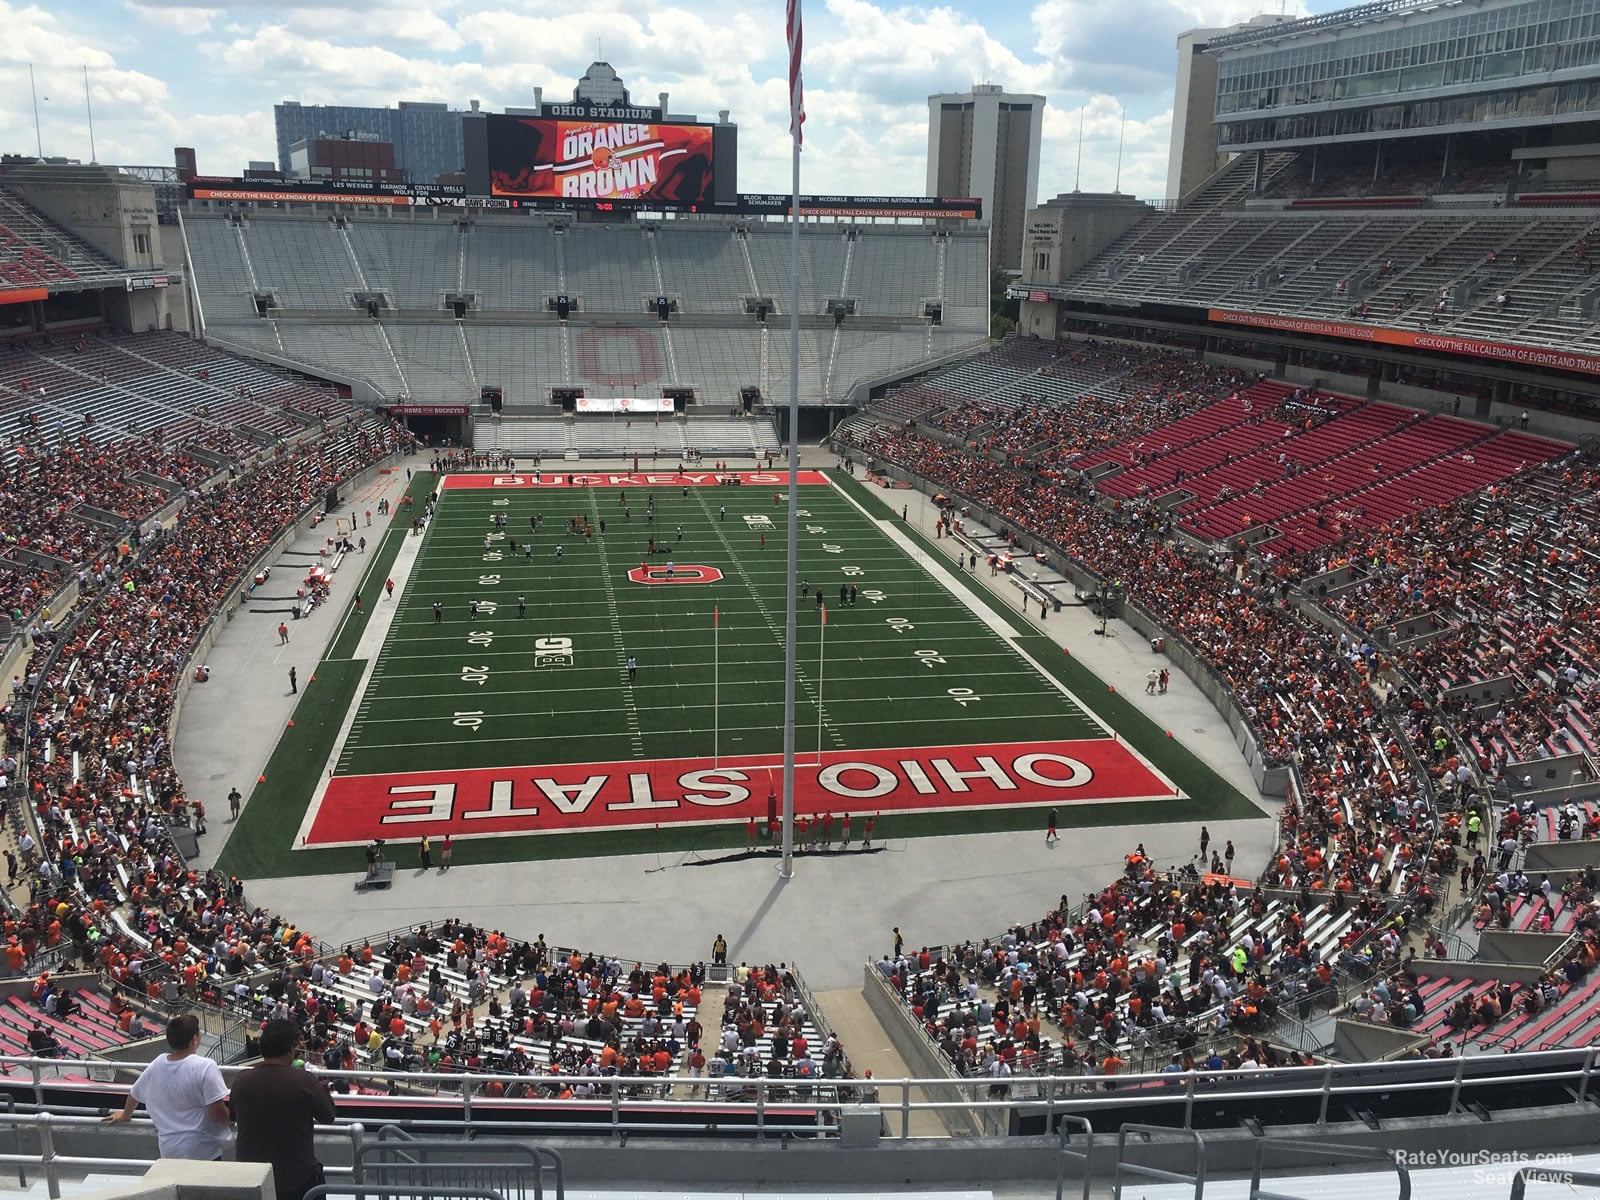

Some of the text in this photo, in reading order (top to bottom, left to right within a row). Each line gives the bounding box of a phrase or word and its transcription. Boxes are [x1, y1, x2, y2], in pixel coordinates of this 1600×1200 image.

[552, 106, 653, 120] OHIO STADIUM
[564, 122, 650, 161] ORANGE
[562, 154, 657, 198] BROWN
[486, 200, 506, 208] POUND
[1270, 319, 1296, 329] CALENDAR
[1304, 323, 1324, 331] EVENTS
[1337, 327, 1356, 336] TRAVEL
[1357, 329, 1374, 338] GUIDE
[1414, 336, 1600, 371] CHECK OUT THE FALL CALENDAR OF EVENTS AND TRAVE
[493, 472, 780, 487] BUCKEYES
[478, 574, 501, 584] 50
[886, 618, 914, 630] 30
[467, 631, 494, 644] 30
[914, 650, 947, 664] 20
[461, 666, 490, 681] 20
[947, 688, 981, 701] 10
[452, 711, 484, 726] 10
[379, 753, 1094, 825] OHIO STATE
[447, 1036, 457, 1048] 75
[466, 1043, 476, 1051] 00
[712, 1064, 720, 1072] 54
